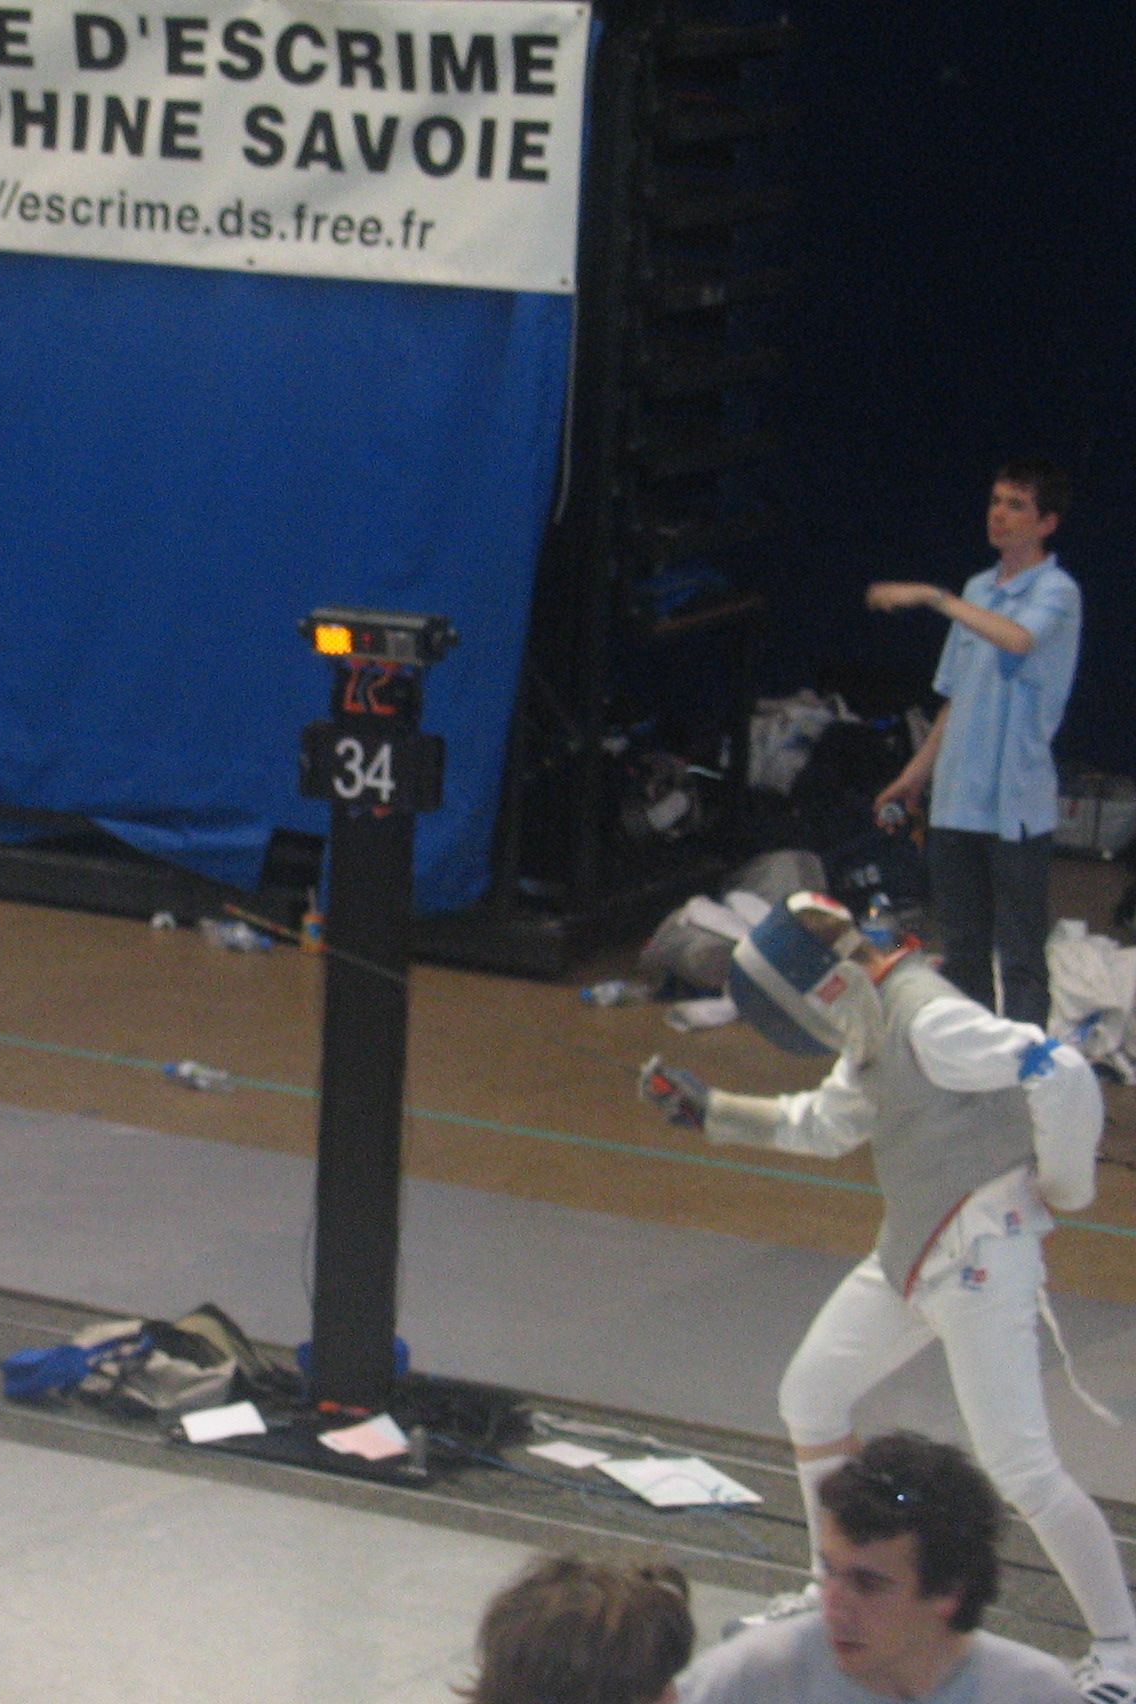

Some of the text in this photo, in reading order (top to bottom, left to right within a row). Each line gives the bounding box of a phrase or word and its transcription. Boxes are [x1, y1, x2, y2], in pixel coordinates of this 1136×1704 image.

[73, 13, 561, 97] D'ESCRIME
[242, 104, 551, 183] SAVOIE
[332, 737, 396, 803] 34
